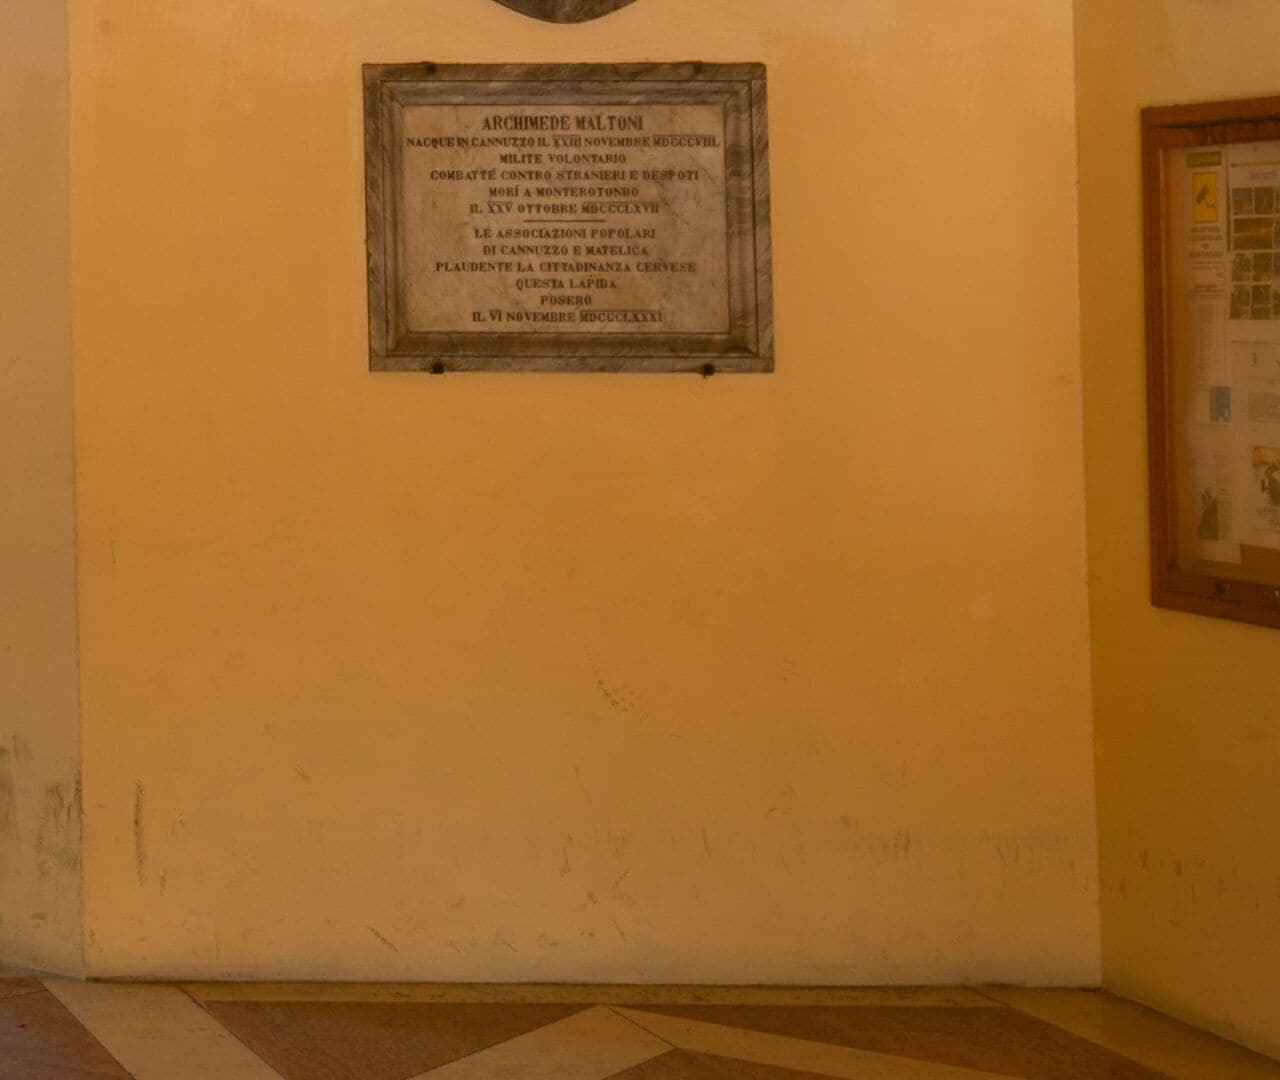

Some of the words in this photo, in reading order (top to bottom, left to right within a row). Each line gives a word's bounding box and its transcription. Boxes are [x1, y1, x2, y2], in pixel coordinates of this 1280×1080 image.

[482, 116, 571, 131] ARCHIMEDE
[575, 116, 643, 131] MALTONI
[406, 137, 457, 149] NACQUE
[471, 136, 535, 148] CANNUZZO
[537, 136, 550, 148] IL
[584, 136, 650, 148] NOVEMBRE
[500, 153, 543, 165] MILITE
[548, 153, 626, 164] VOLONTARIO
[500, 170, 552, 181] CONTRO
[556, 170, 626, 181] STRANIERI
[630, 170, 638, 181] E
[642, 170, 699, 181] DESPOTI
[524, 187, 532, 198] A
[535, 187, 639, 198] MONTEROTONDO
[470, 203, 484, 214] IL
[487, 201, 513, 214] XXV
[517, 203, 578, 214] OTTOBRE
[475, 228, 492, 239] LE
[496, 228, 587, 239] ASSOCIAZIONI
[591, 228, 656, 239] POPOLARI
[483, 245, 497, 256] DI
[500, 245, 569, 256] CANNUZZO
[573, 245, 581, 256] E
[585, 245, 648, 256] MATELICA
[436, 262, 513, 273] PLAUDENTE
[517, 262, 534, 273] LA
[539, 262, 631, 273] CITTADINANZA
[636, 262, 696, 273] CERVESE
[516, 279, 565, 291] QUESTA
[569, 279, 616, 290] LAPIDA
[540, 295, 592, 306] POSERO
[472, 311, 485, 322] IL
[489, 309, 503, 322] VI
[506, 311, 576, 322] NOVEMBRE
